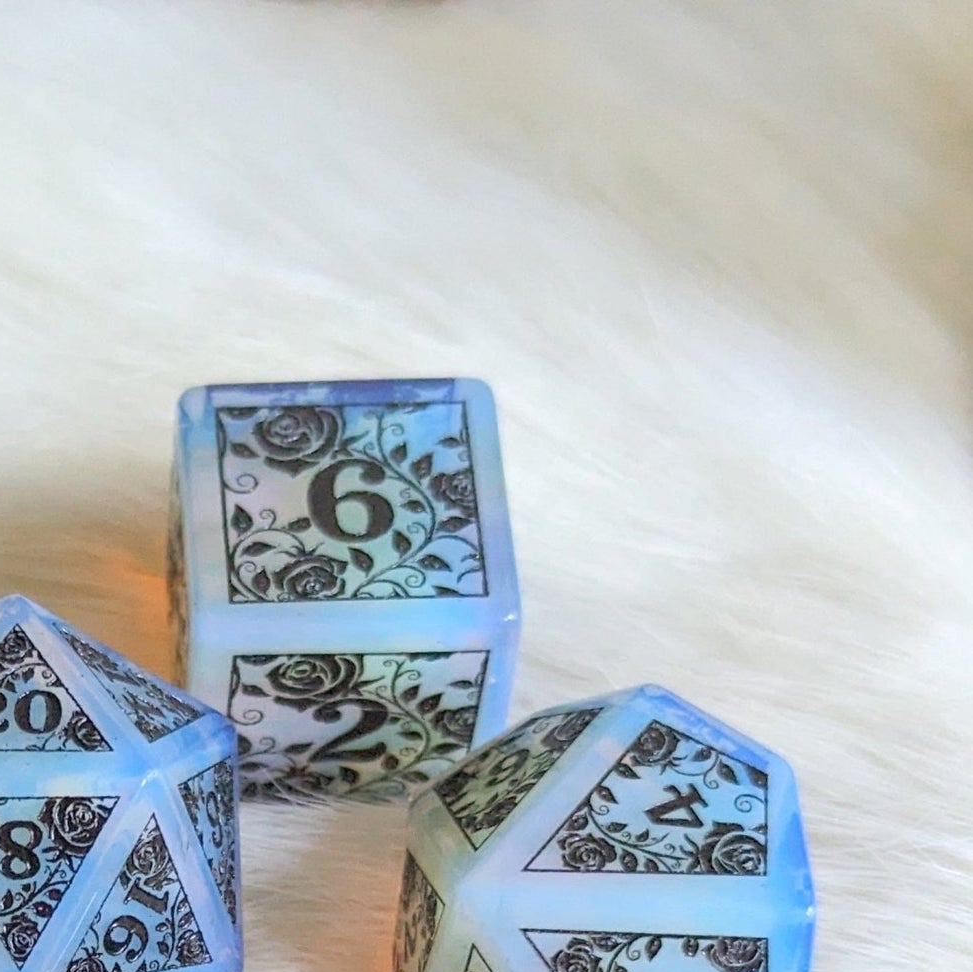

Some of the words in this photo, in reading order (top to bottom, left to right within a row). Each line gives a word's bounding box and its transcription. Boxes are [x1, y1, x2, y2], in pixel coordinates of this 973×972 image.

[307, 458, 395, 543] 6
[308, 698, 388, 762] 2
[645, 781, 710, 829] 4
